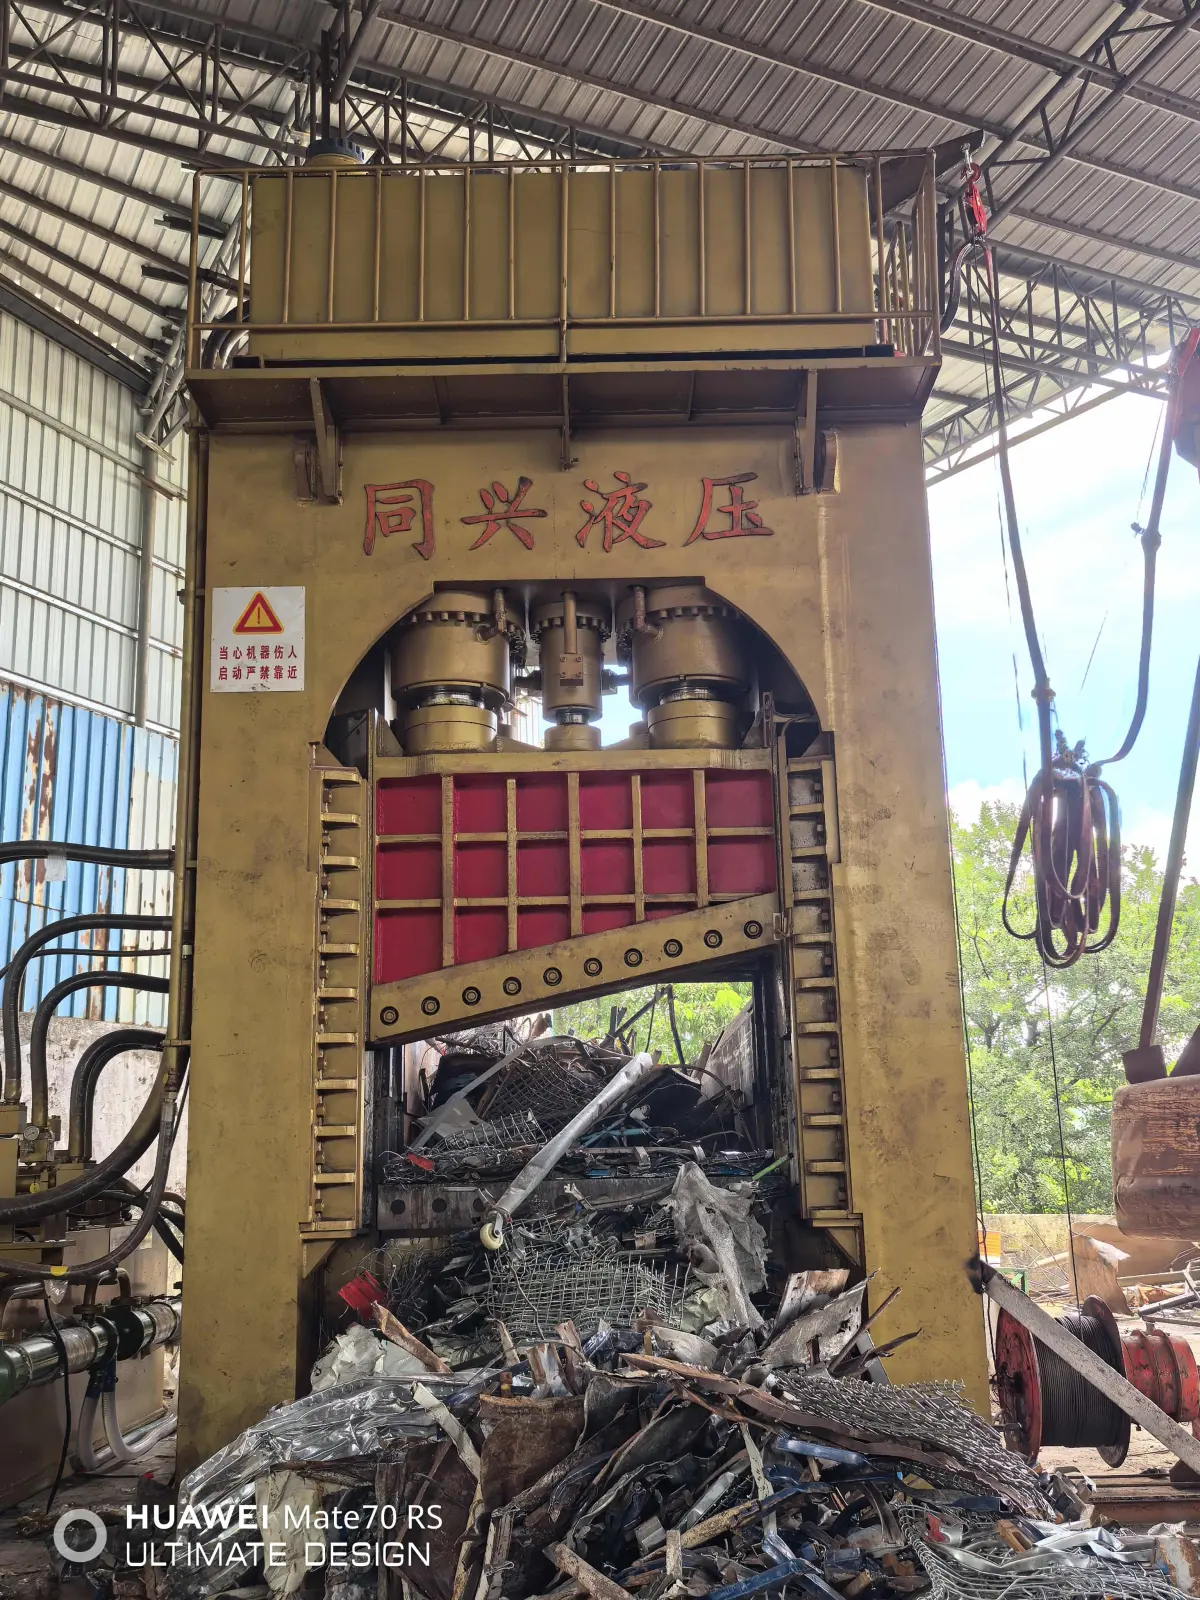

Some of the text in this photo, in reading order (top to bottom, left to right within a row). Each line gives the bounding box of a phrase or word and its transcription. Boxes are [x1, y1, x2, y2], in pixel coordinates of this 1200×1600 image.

[363, 471, 775, 561] 同兴液压
[219, 645, 297, 660] 当心机器伤人
[219, 665, 297, 680] 启动严禁靠近
